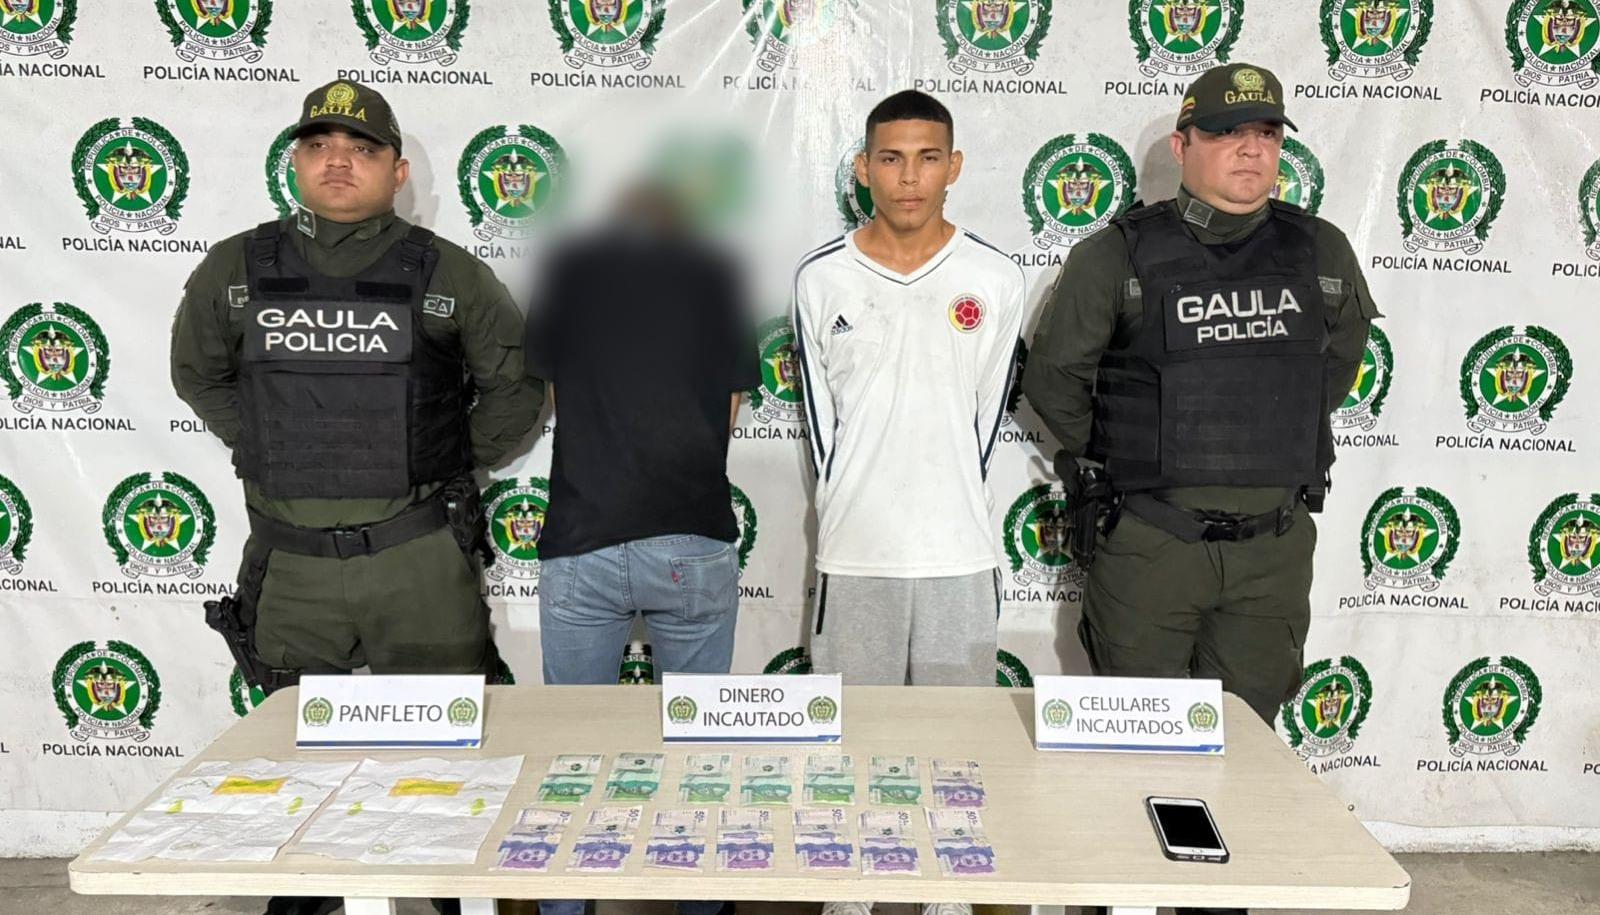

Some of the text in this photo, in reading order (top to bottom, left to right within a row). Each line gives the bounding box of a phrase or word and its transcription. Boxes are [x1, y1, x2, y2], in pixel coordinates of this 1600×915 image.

[19, 64, 105, 78] NACIONAL
[144, 63, 300, 82] POLICÍA NACIONAL
[338, 67, 493, 84] POLICÍA NACIONAL
[531, 70, 686, 88] POLICÍA NACIONAL
[914, 77, 1067, 94] POLICÍA NACIONAL
[1105, 79, 1168, 95] POLICÍA
[1295, 83, 1442, 100] POLICÍA NACIONAL
[1225, 90, 1276, 104] GAULA
[1480, 88, 1540, 105] POLICÍA
[310, 105, 367, 122] GAULA
[62, 236, 124, 251] POLICÍA
[1010, 251, 1062, 266] OLICÍA
[1372, 254, 1511, 273] POLICÍA NACIONAL
[1177, 288, 1302, 324] GAULA
[257, 309, 399, 331] GAULA
[1197, 316, 1288, 343] POLICÍA
[265, 332, 389, 353] POLICIA
[52, 418, 136, 430] NACIONAL
[171, 420, 206, 432] POLI
[732, 423, 782, 439] OLICÍA
[999, 431, 1043, 443] IONAL
[1436, 434, 1576, 452] POLICÍA NACIONAL
[93, 580, 236, 595] POLICÍA NACIONAL
[1004, 587, 1082, 604] LICÍA NACI
[1339, 591, 1468, 609] POLICÍA NACIONAL
[1500, 597, 1600, 612] POLICÍA NACI
[720, 688, 784, 702] DINERO
[1080, 697, 1170, 712] CELULARES
[340, 705, 442, 722] PANFLETO
[704, 712, 804, 726] INCAUTADO
[1077, 719, 1183, 735] INCAUTADOS
[43, 742, 184, 757] POLICÍA NACIONAL
[1320, 756, 1381, 774] NACIONAL
[1417, 758, 1547, 772] POLICÍA NACIONAL
